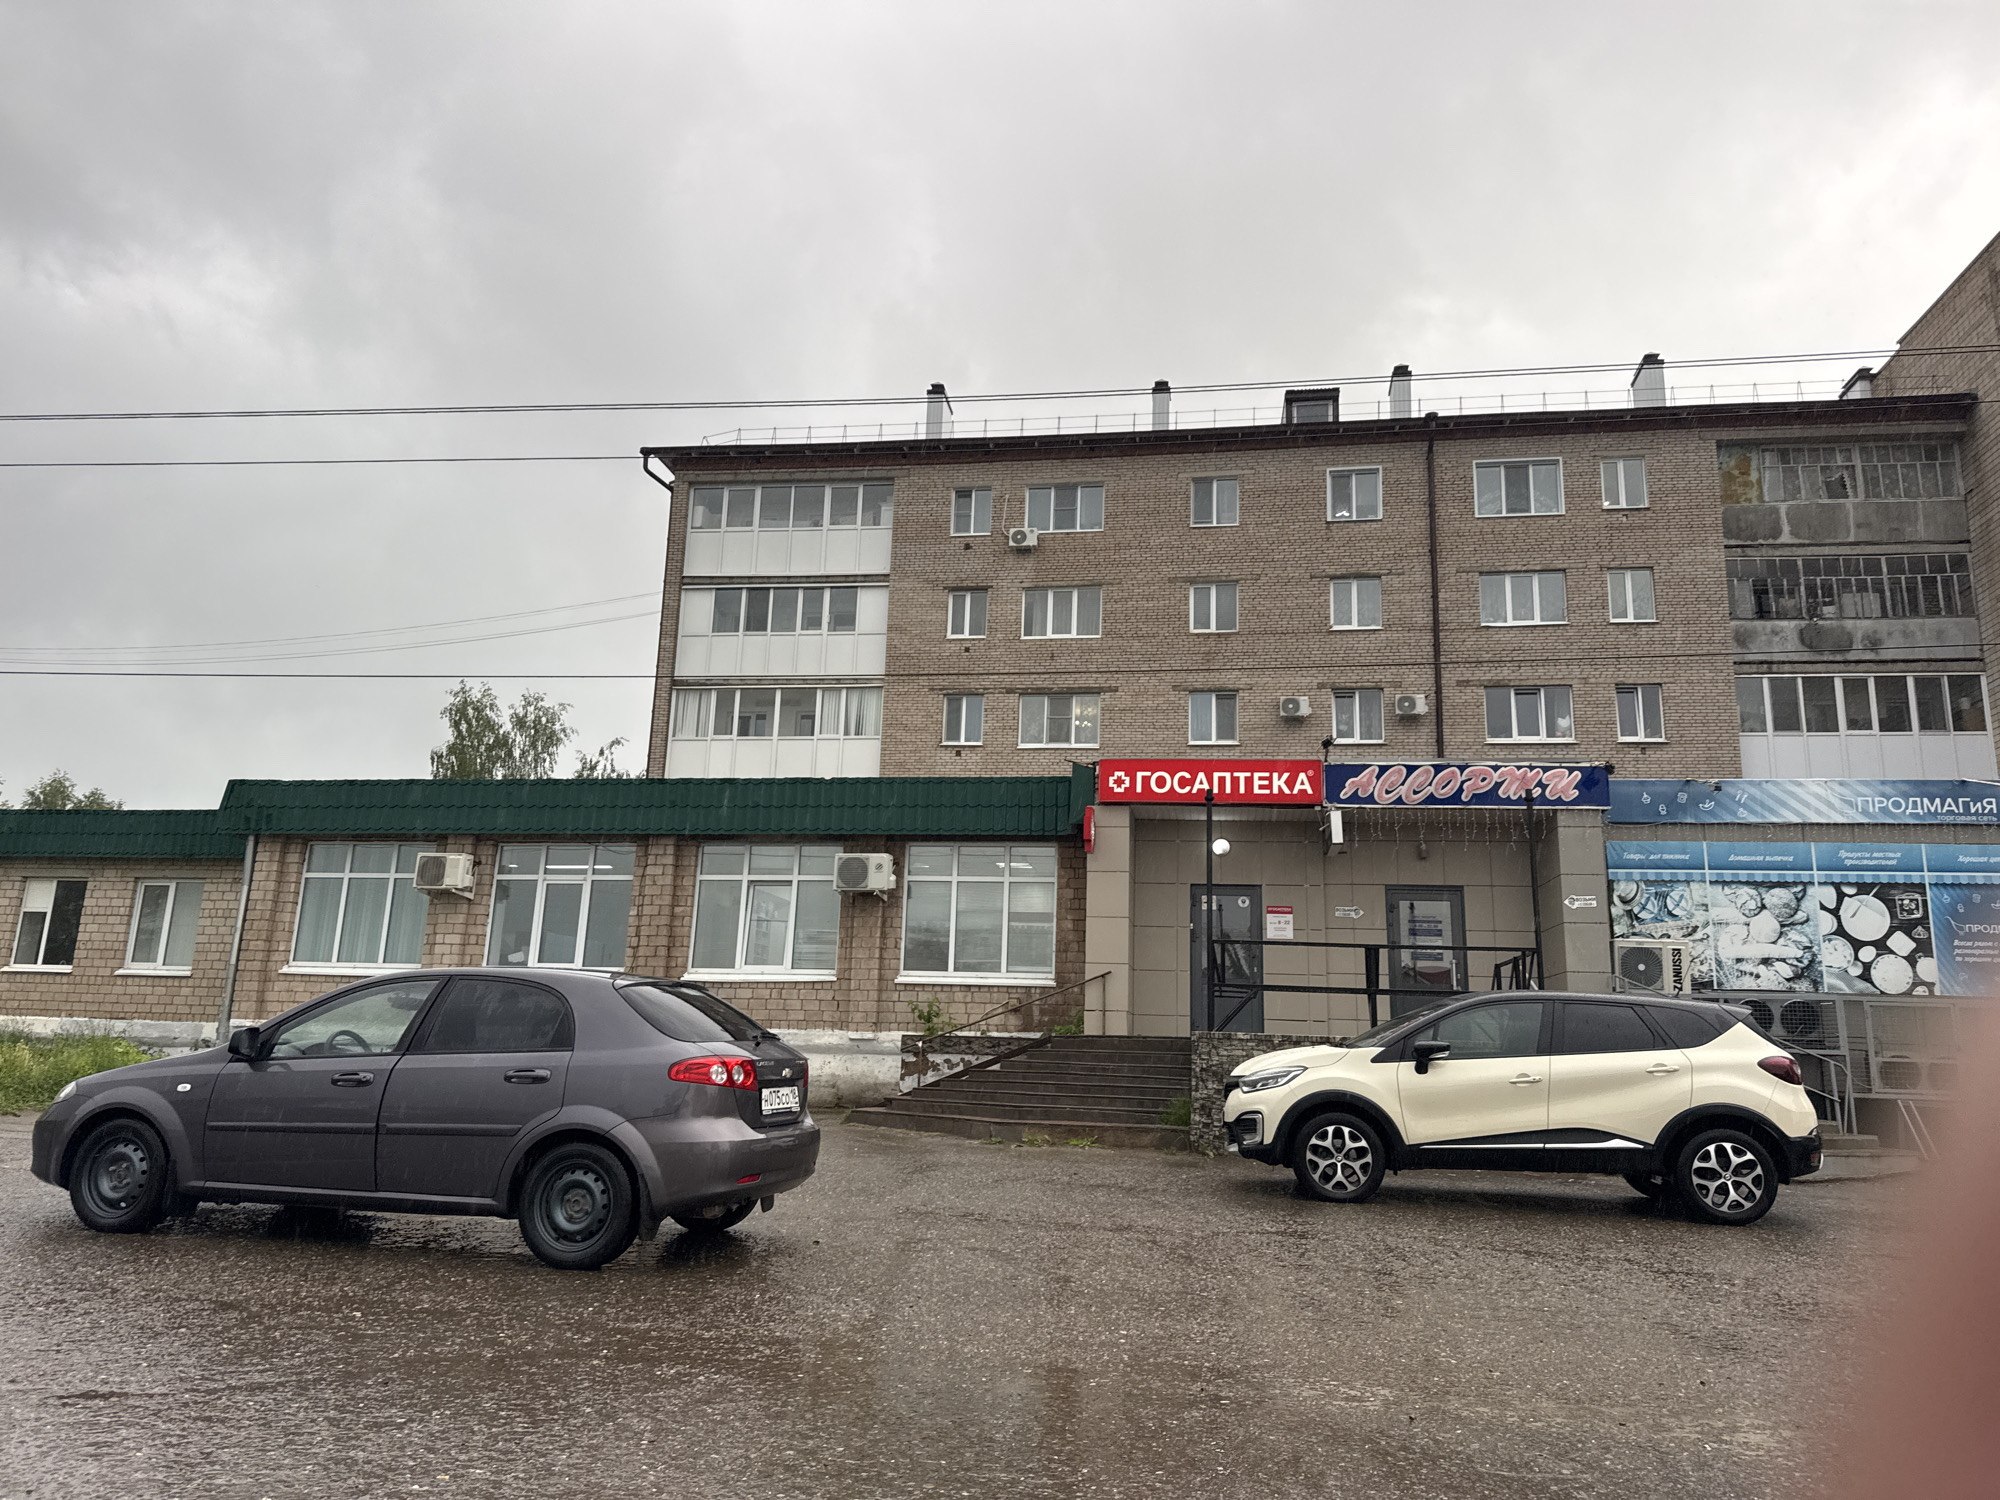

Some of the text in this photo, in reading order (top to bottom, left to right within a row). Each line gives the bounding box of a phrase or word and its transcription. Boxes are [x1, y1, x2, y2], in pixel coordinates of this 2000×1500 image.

[1135, 771, 1313, 795] ГОСАПТЕКА
[1339, 765, 1581, 804] АССОРТИ
[1857, 797, 1998, 816] ПРОДМАГиЯ
[1966, 924, 2000, 934] ПРОД
[1672, 949, 1683, 992] ZANUSSI
